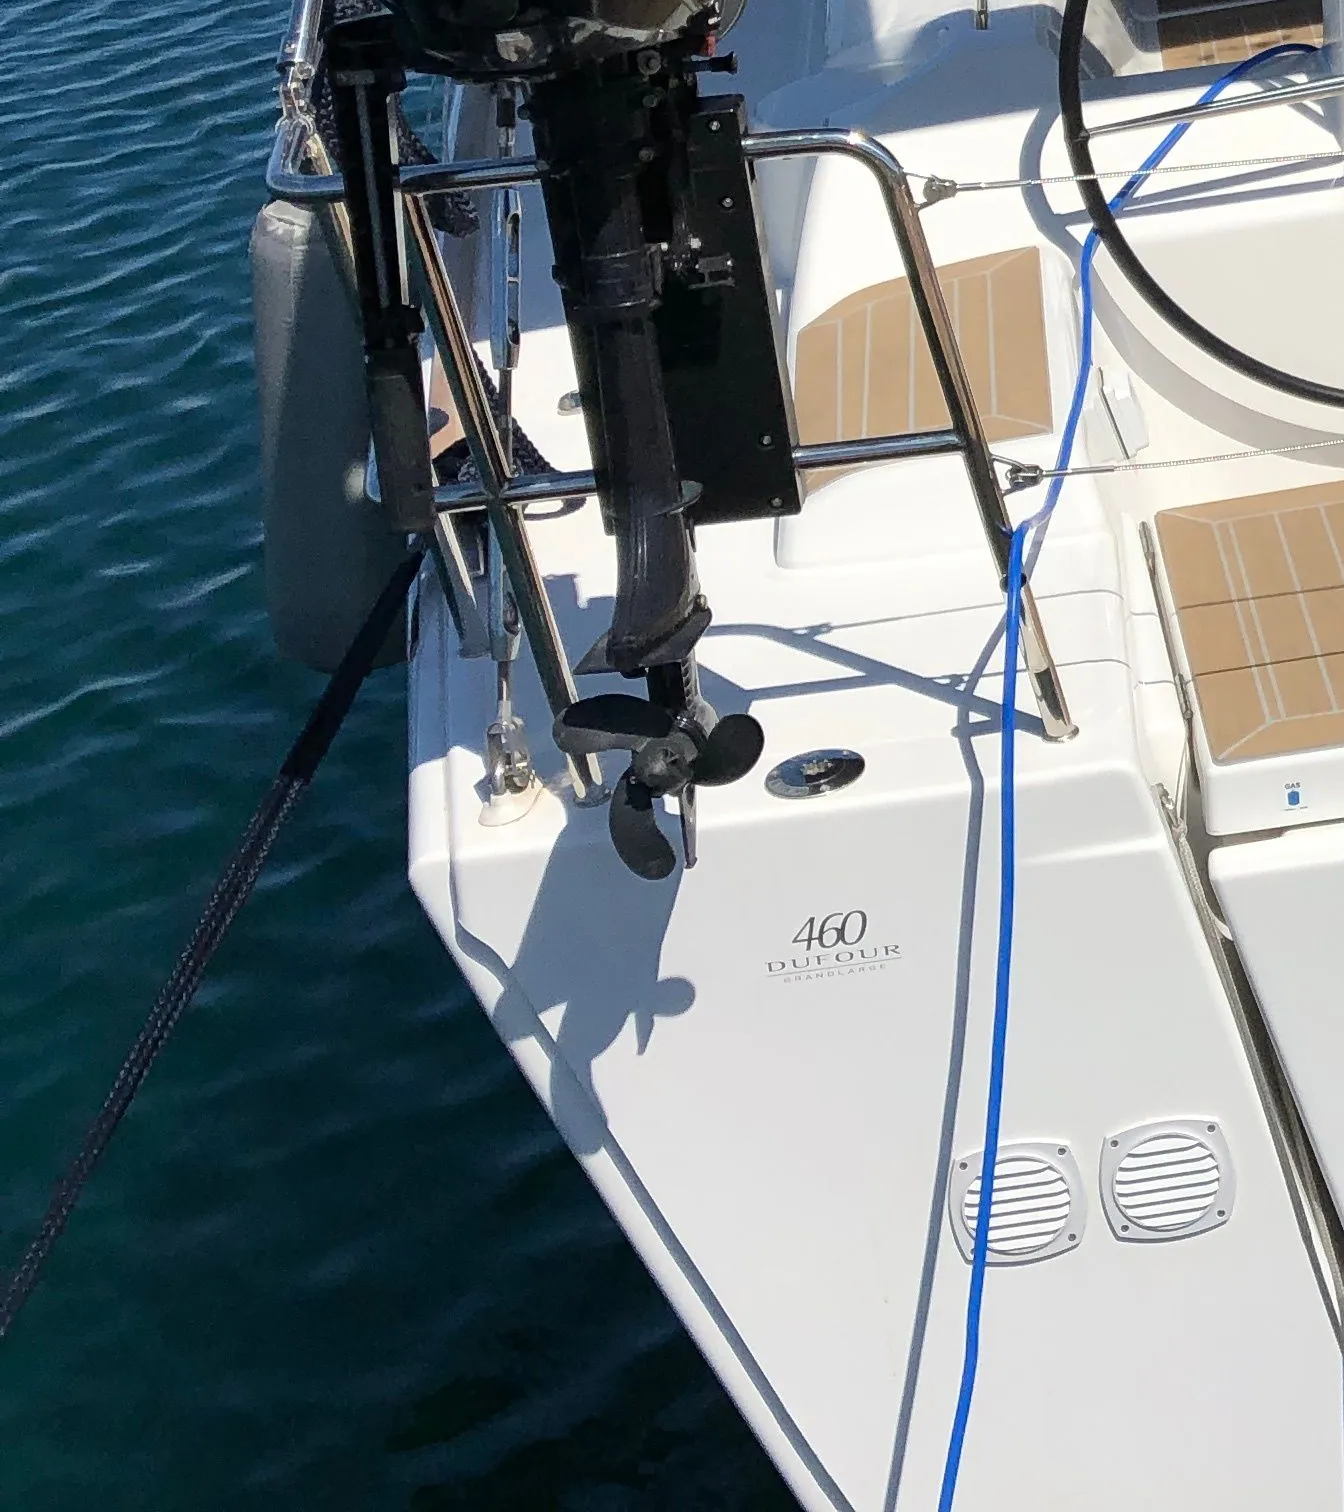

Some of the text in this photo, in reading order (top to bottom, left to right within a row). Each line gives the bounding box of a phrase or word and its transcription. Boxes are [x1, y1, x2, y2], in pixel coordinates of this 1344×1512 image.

[1284, 782, 1301, 790] GAS
[792, 909, 867, 951] 460
[767, 944, 901, 973] DUFOUR
